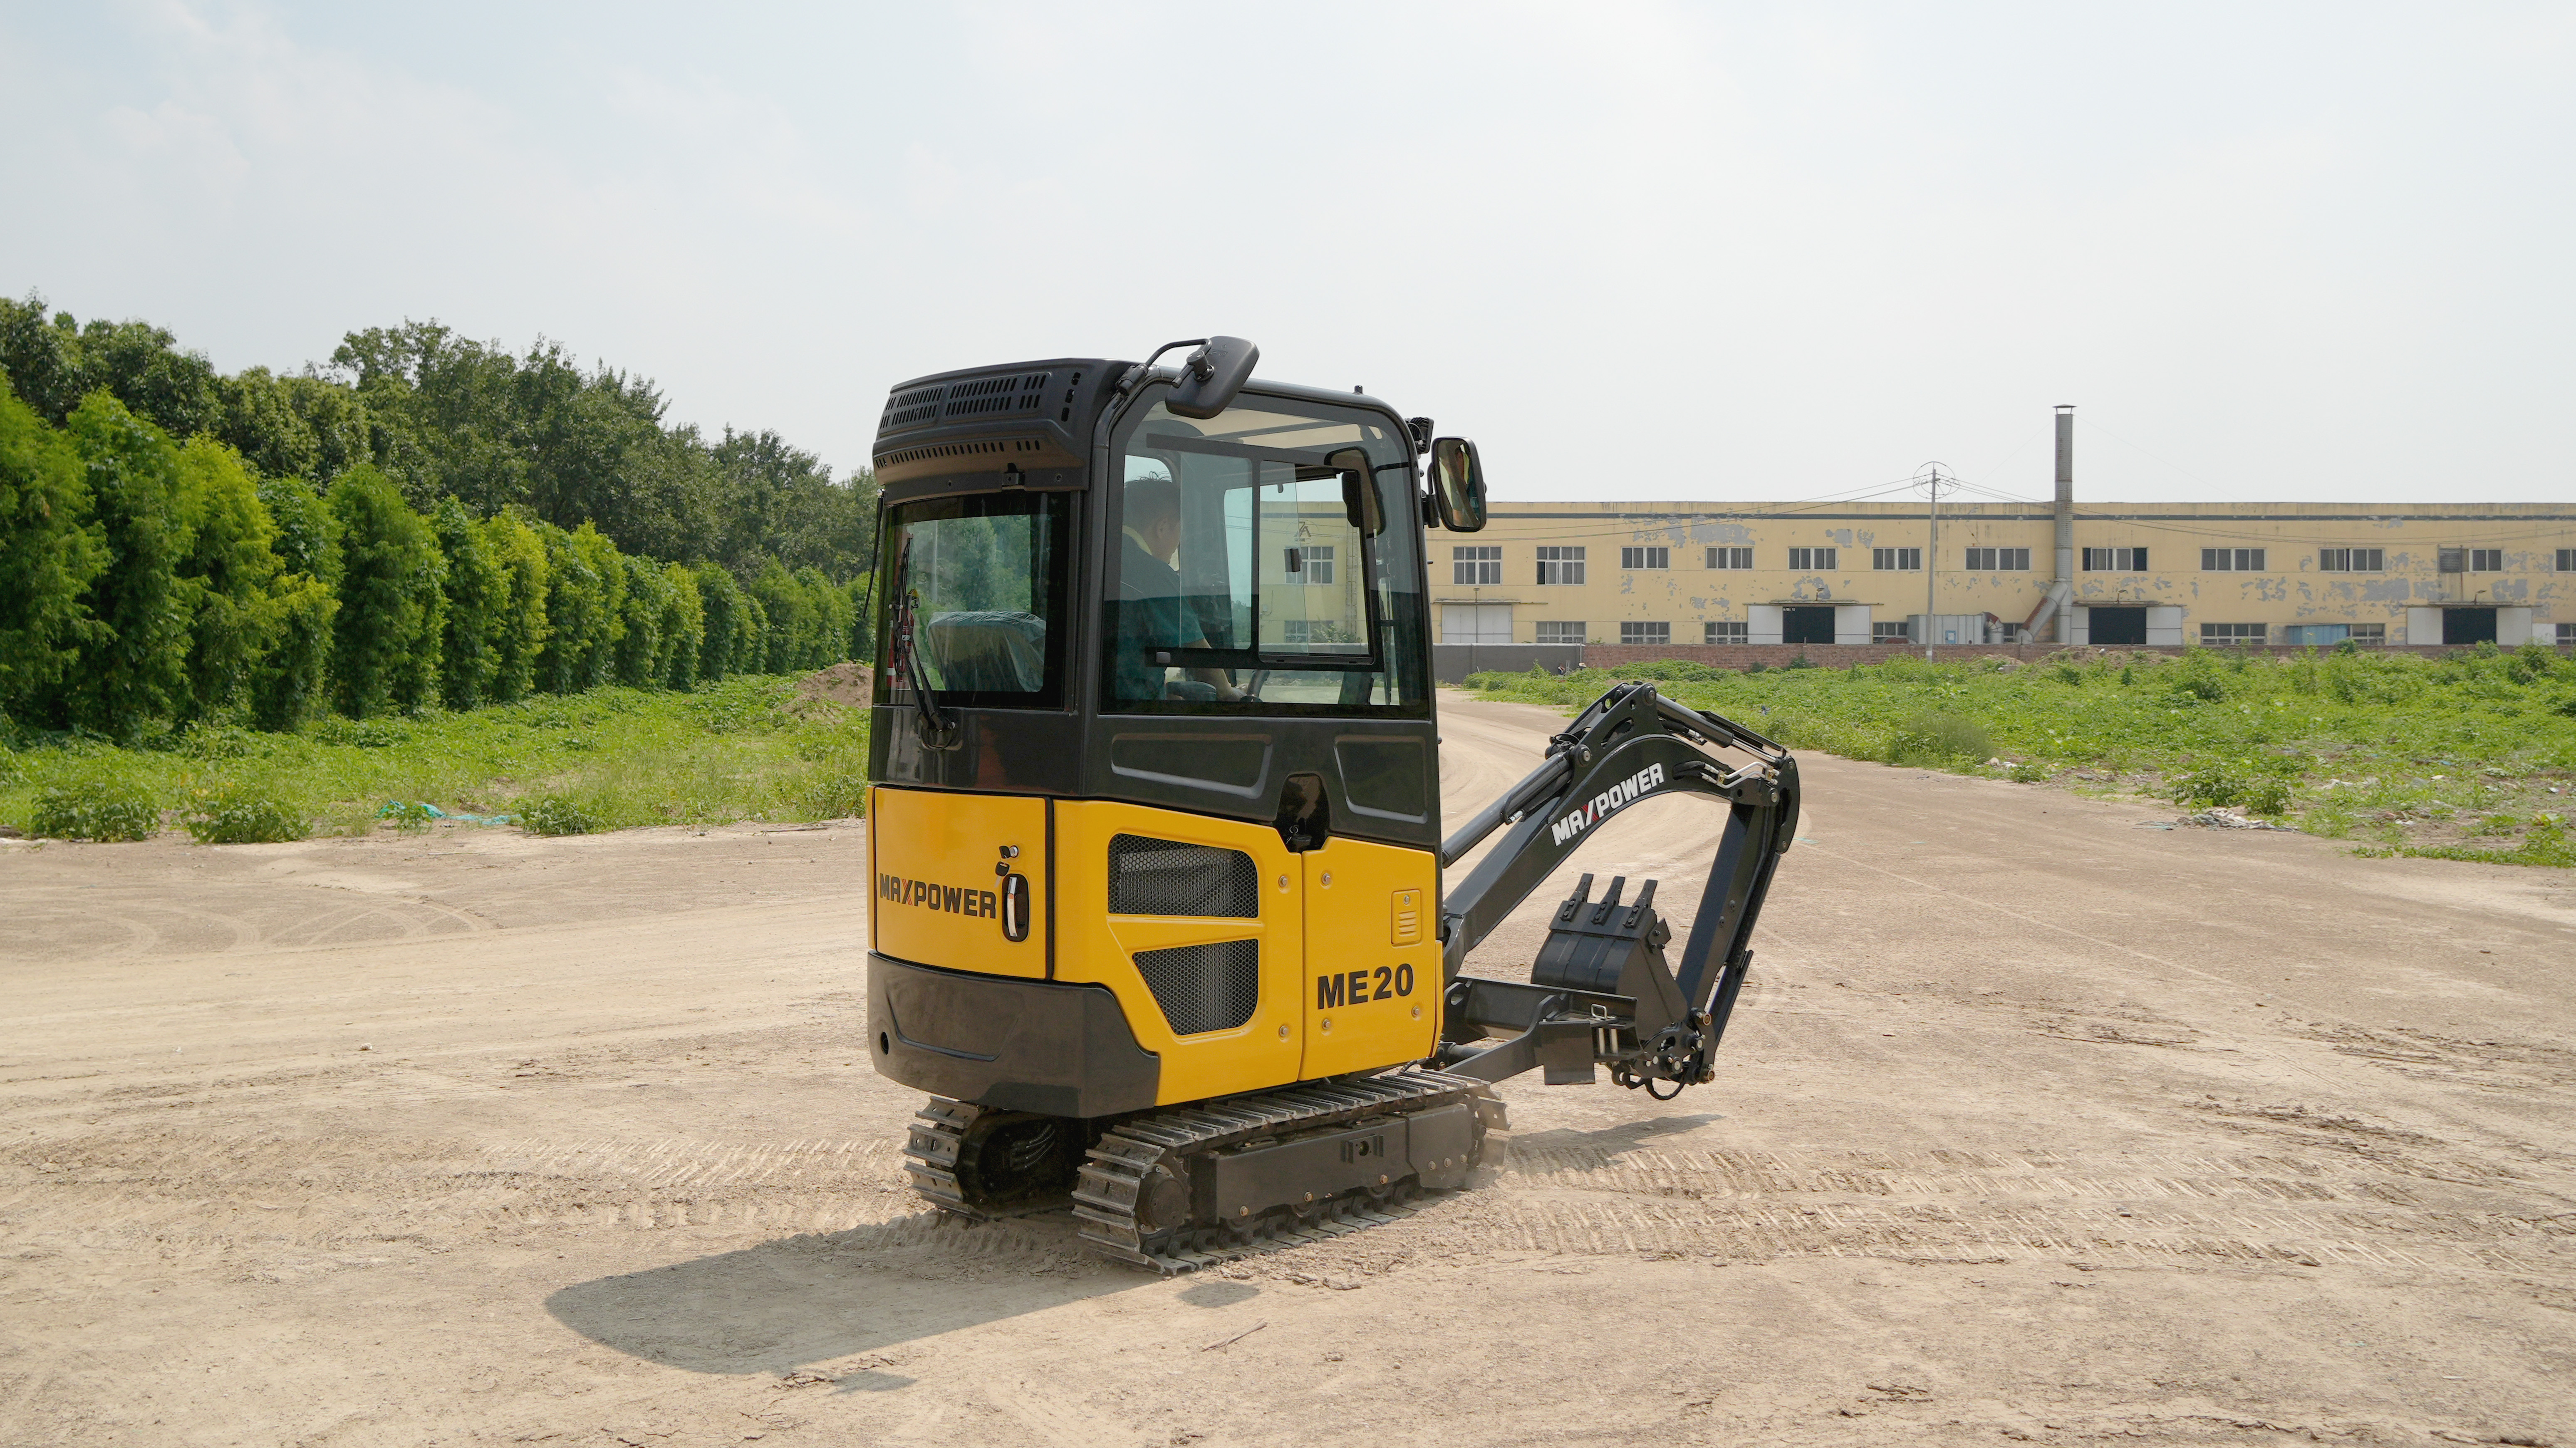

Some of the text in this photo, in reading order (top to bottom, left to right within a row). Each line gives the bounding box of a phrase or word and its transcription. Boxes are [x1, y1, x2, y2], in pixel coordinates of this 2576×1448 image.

[1551, 762, 1664, 846] MAXPOWER
[880, 873, 996, 919] MAXPOWER
[1318, 963, 1413, 1009] ME20
